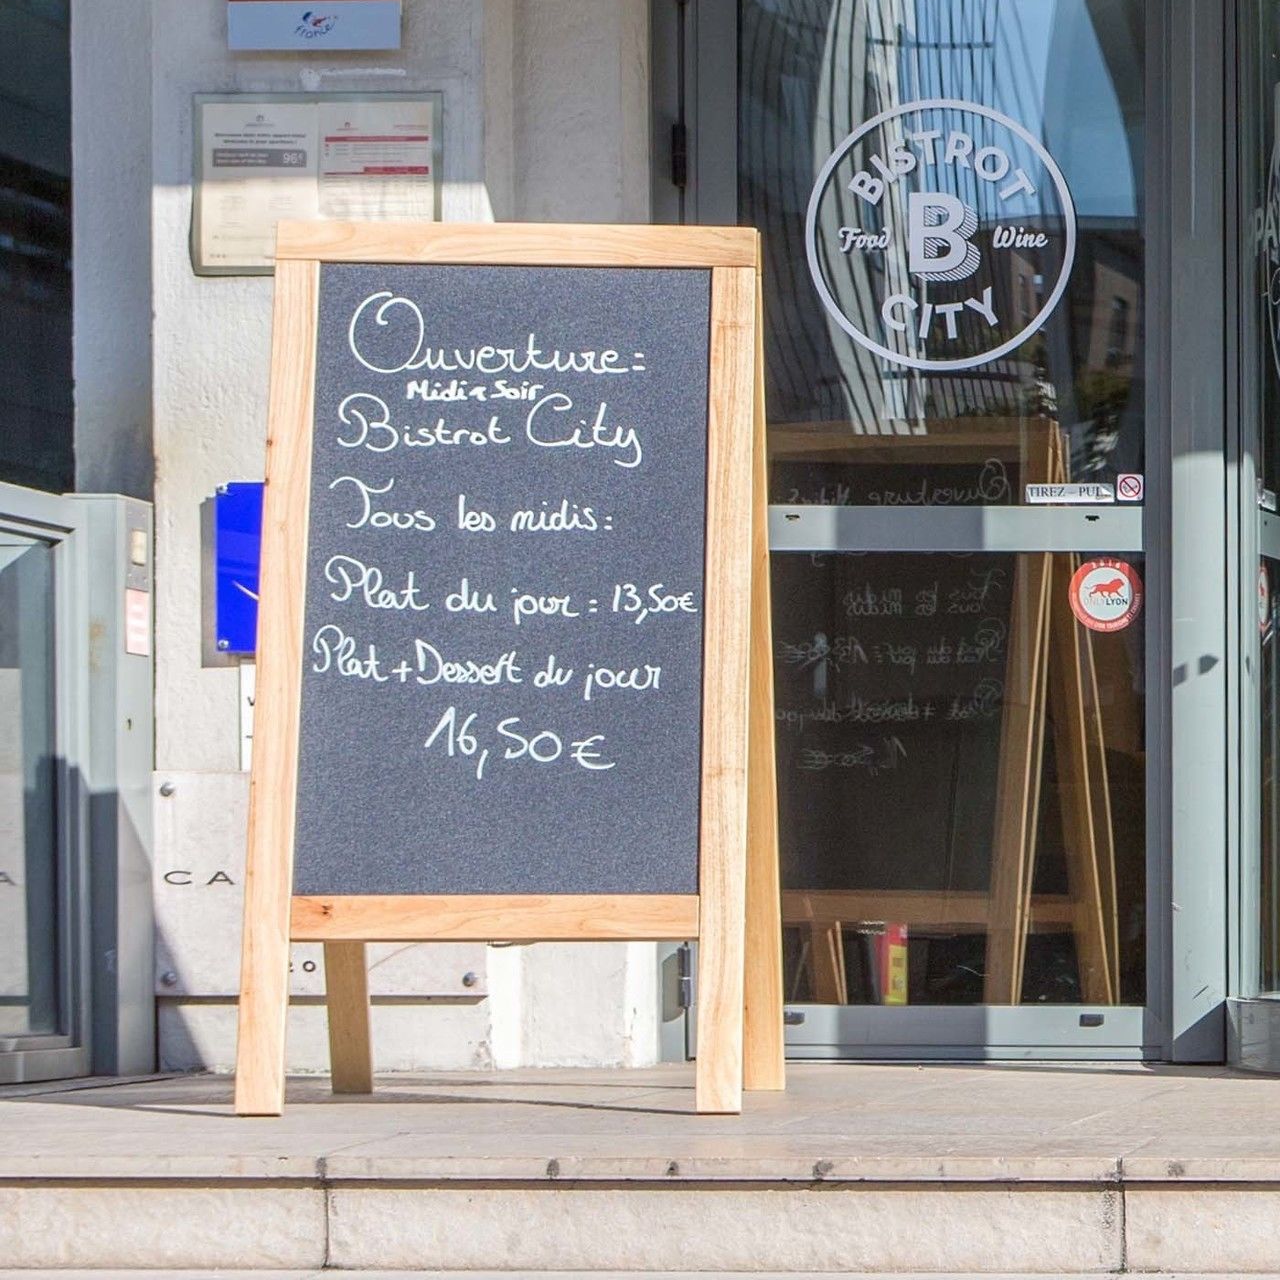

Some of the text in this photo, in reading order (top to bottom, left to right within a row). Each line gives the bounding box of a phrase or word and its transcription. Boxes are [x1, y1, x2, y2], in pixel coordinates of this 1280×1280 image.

[848, 129, 1036, 205] BISTROT
[837, 226, 890, 253] Food
[992, 226, 1049, 249] Wine
[881, 286, 999, 339] CITY
[406, 379, 467, 401] Midi
[491, 381, 544, 400] Soir
[337, 393, 642, 468] Bistrot City
[329, 476, 436, 531] Tous
[458, 494, 496, 531] les
[1029, 486, 1066, 497] TIREZ
[325, 555, 429, 610] Plat
[446, 578, 498, 611] du
[612, 583, 698, 624] 13,50€
[533, 655, 573, 687] du
[584, 666, 662, 700] jour
